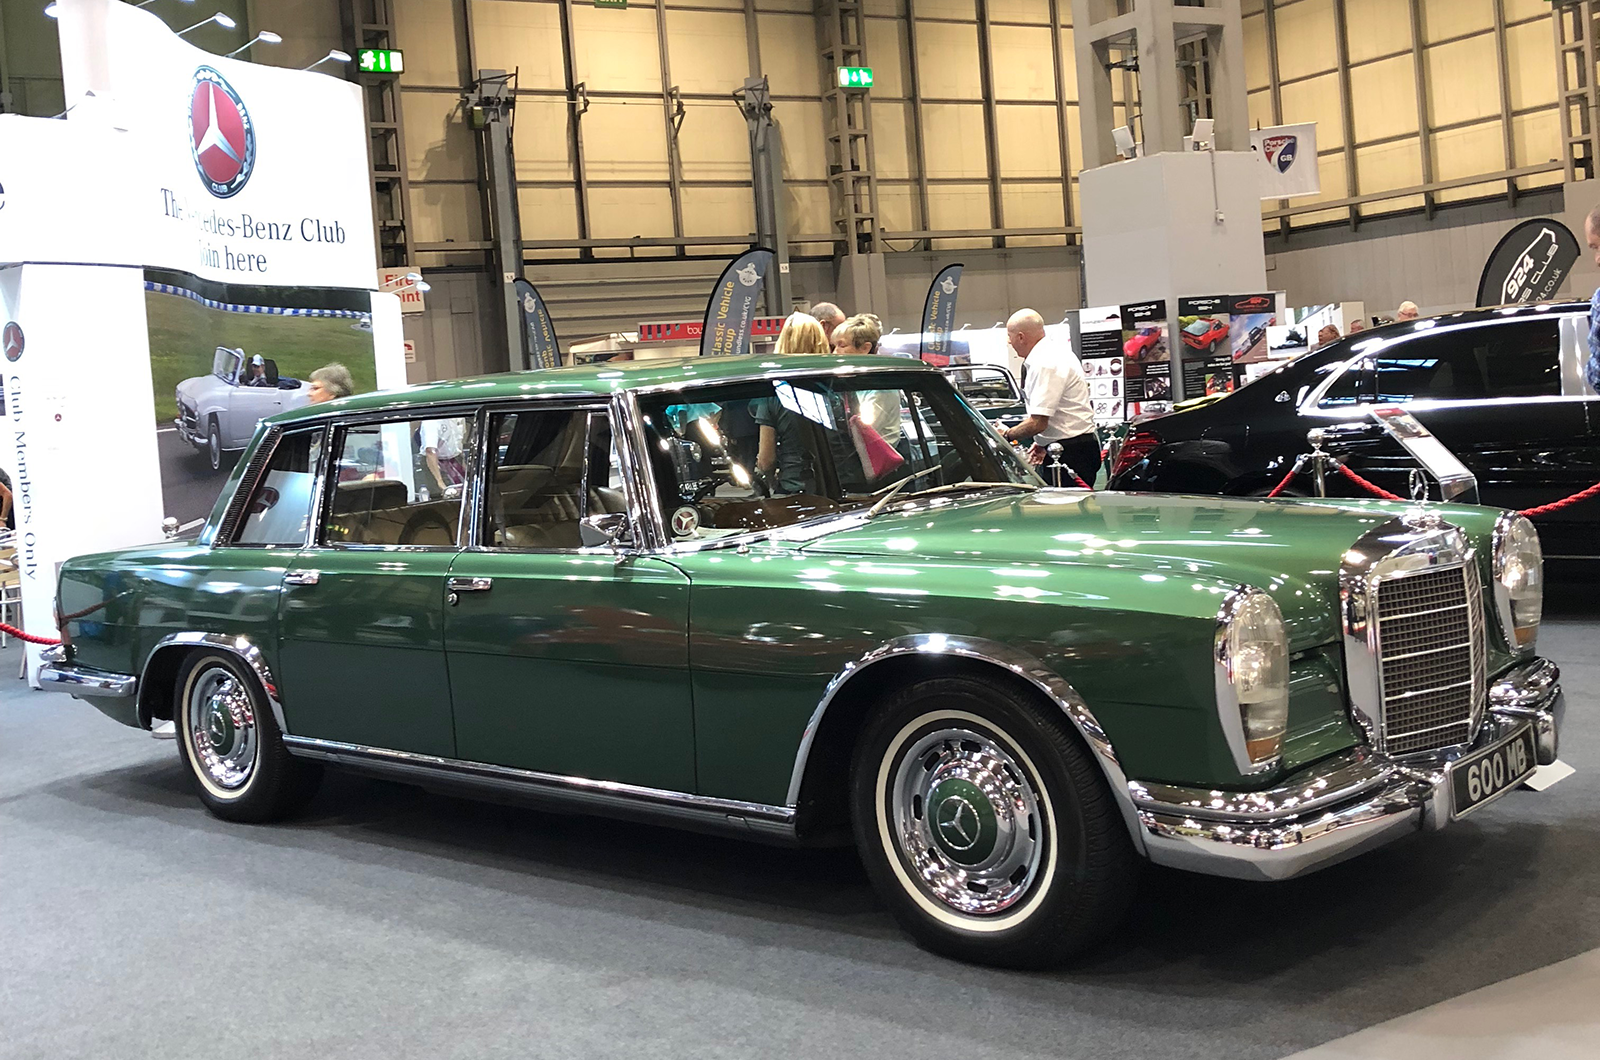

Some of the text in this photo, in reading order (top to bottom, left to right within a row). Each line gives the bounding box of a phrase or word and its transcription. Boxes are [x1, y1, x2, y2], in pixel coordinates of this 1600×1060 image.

[1280, 154, 1293, 162] GB
[184, 200, 293, 241] edes-Benz
[300, 217, 346, 244] Club
[224, 245, 268, 273] here
[1530, 243, 1559, 285] CLUB
[385, 274, 414, 287] Fire
[1506, 254, 1535, 300] 924
[396, 290, 421, 302] int
[717, 281, 734, 320] Vehicle
[930, 291, 940, 320] Vehicle
[723, 328, 737, 355] roup
[10, 376, 38, 580] Club Members Only
[1467, 738, 1527, 802] 600 MB
